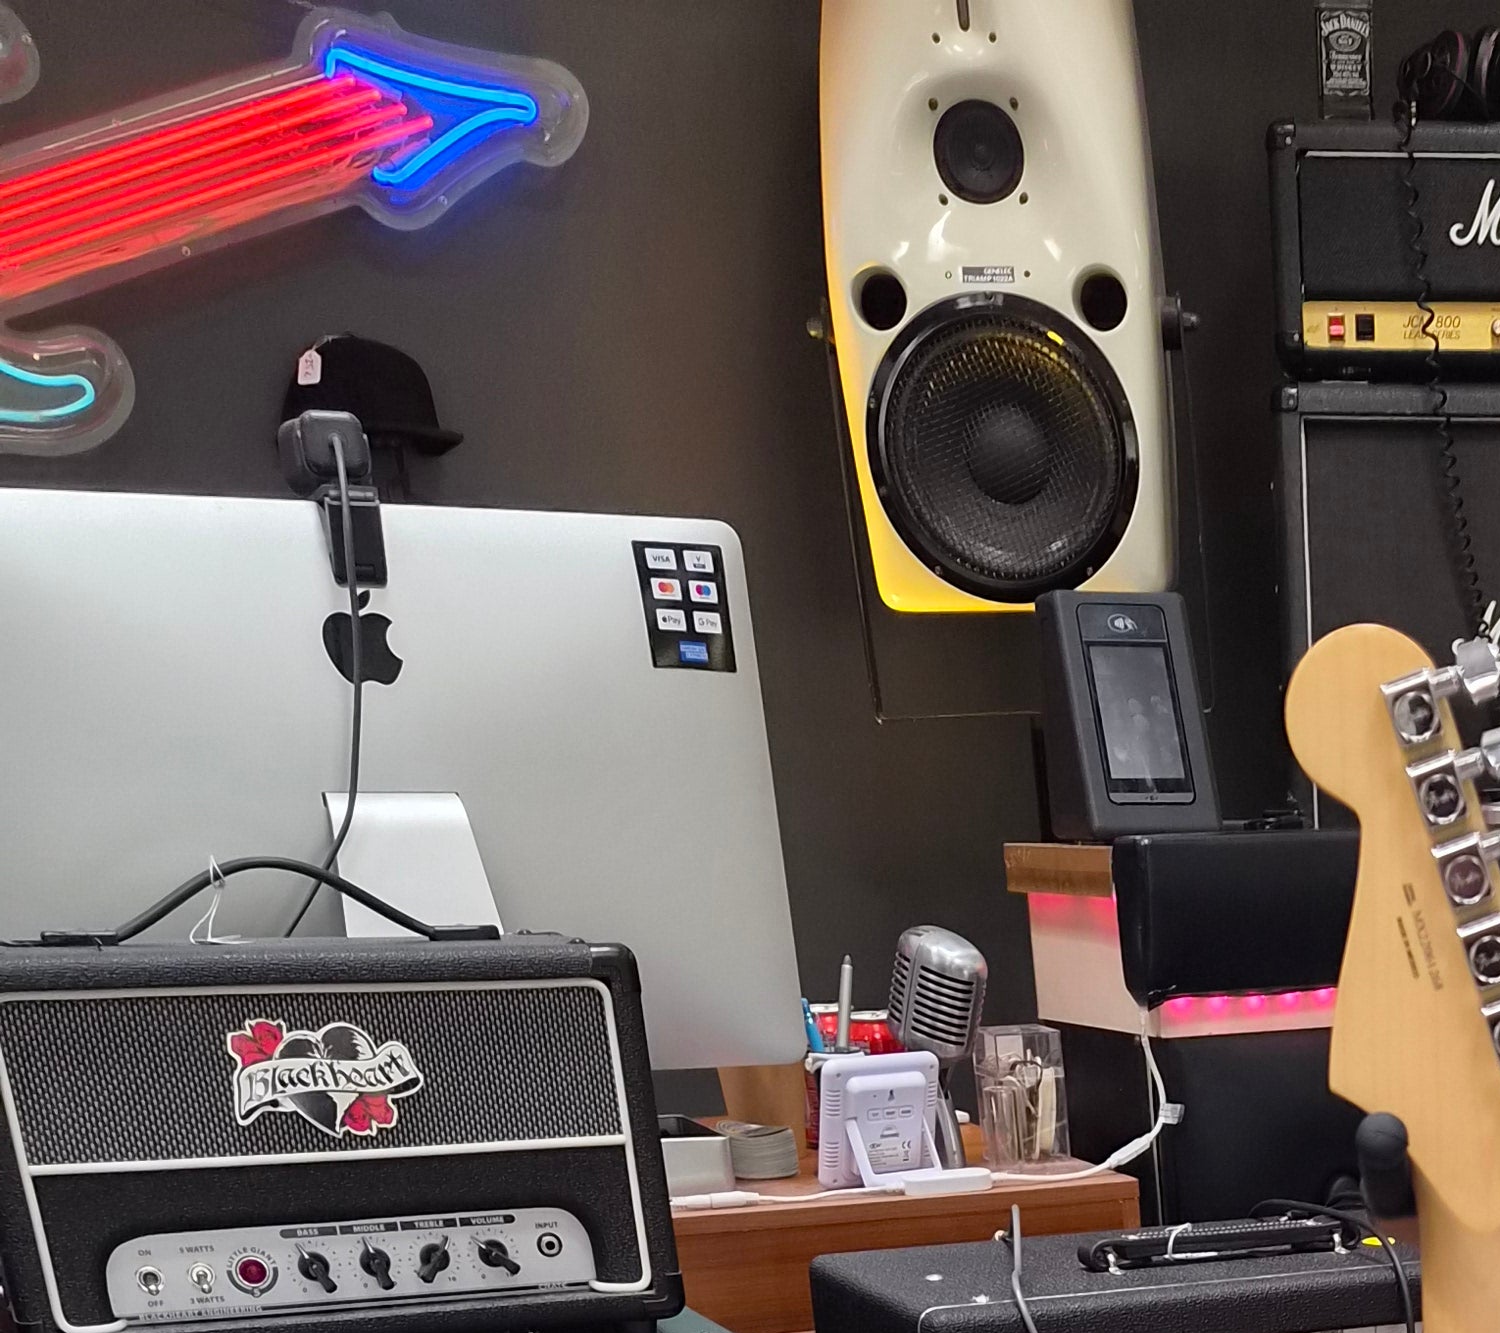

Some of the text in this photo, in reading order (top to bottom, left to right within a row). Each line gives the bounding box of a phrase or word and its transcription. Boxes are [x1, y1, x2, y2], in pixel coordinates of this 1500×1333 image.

[1435, 315, 1461, 328] 800
[246, 1050, 410, 1101] Blackheart
[353, 1224, 386, 1233] MIDDLE
[414, 1220, 444, 1229] TREBLE
[535, 1221, 558, 1229] INPUT
[296, 1228, 319, 1236] BASS
[138, 1249, 152, 1257] ON
[185, 1245, 215, 1254] WATTS
[250, 1246, 276, 1268] GIANT
[148, 1300, 164, 1308] OFF
[196, 1296, 225, 1305] WATTS
